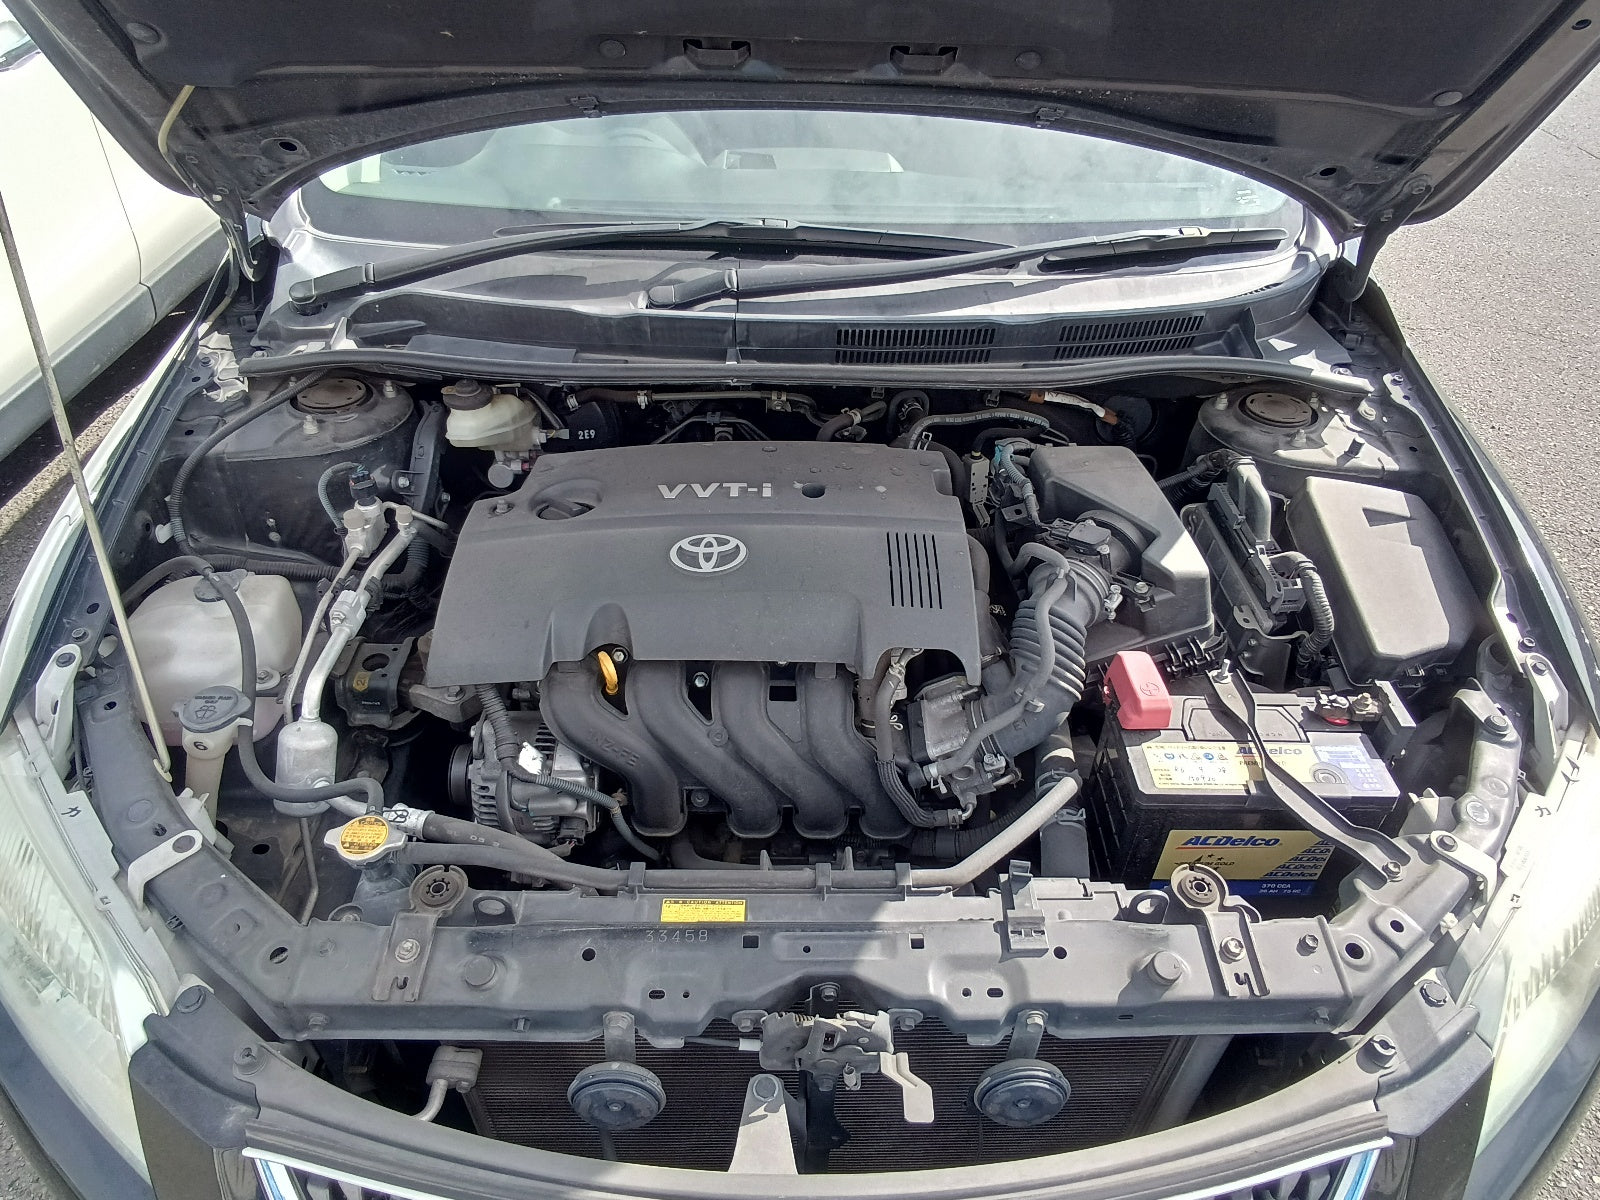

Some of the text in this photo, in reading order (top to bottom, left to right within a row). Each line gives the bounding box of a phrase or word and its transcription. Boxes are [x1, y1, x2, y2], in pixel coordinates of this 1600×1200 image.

[578, 429, 596, 440] 2E9
[657, 482, 773, 499] VVT-i
[193, 741, 209, 751] 6
[1182, 835, 1281, 847] ACDelco
[646, 929, 709, 943] 33458
